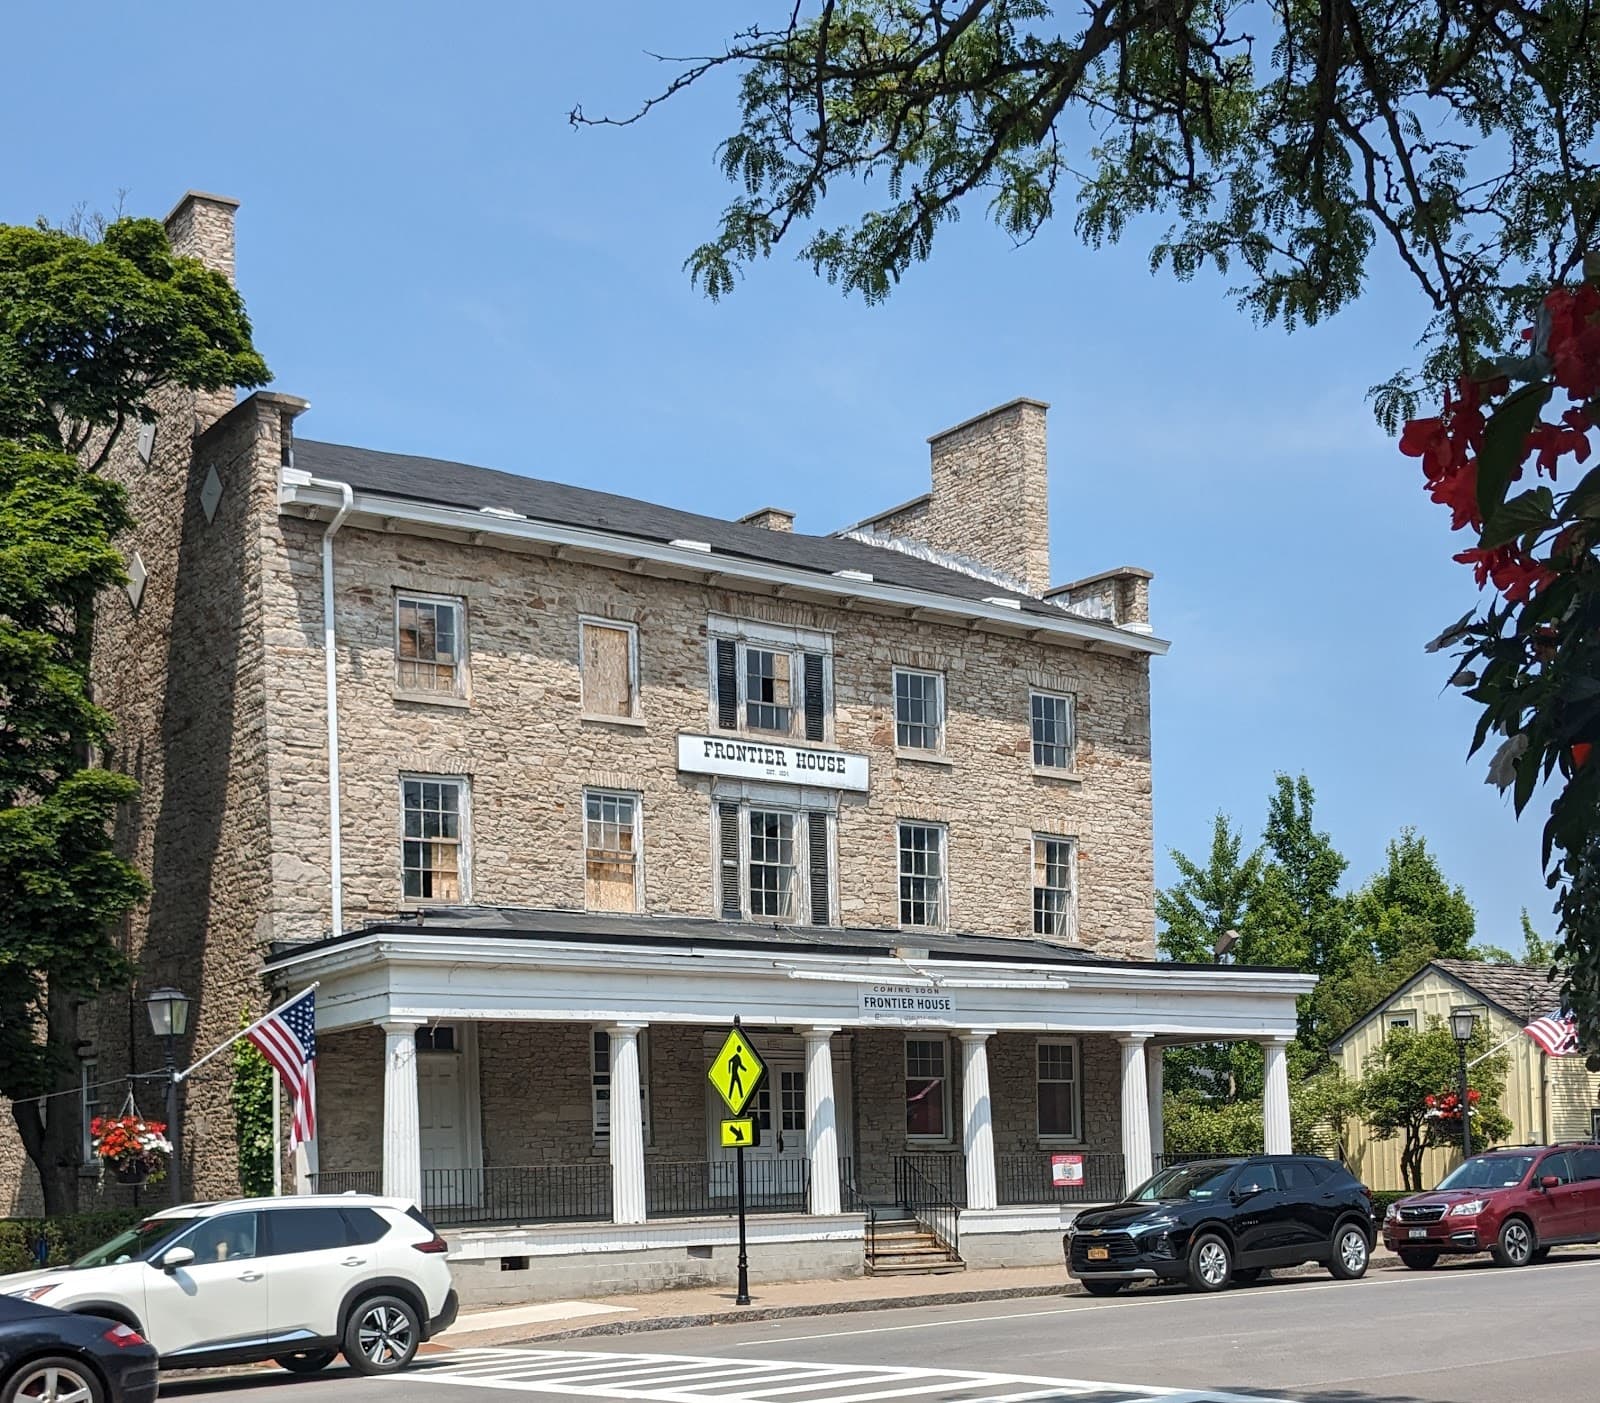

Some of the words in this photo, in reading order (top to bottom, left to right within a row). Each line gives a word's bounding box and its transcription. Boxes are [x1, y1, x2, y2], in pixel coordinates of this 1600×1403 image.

[703, 740, 788, 767] FRONTIER
[796, 752, 846, 774] HOUSE
[864, 997, 914, 1009] FRONTIER
[917, 1000, 951, 1010] HOUSE
